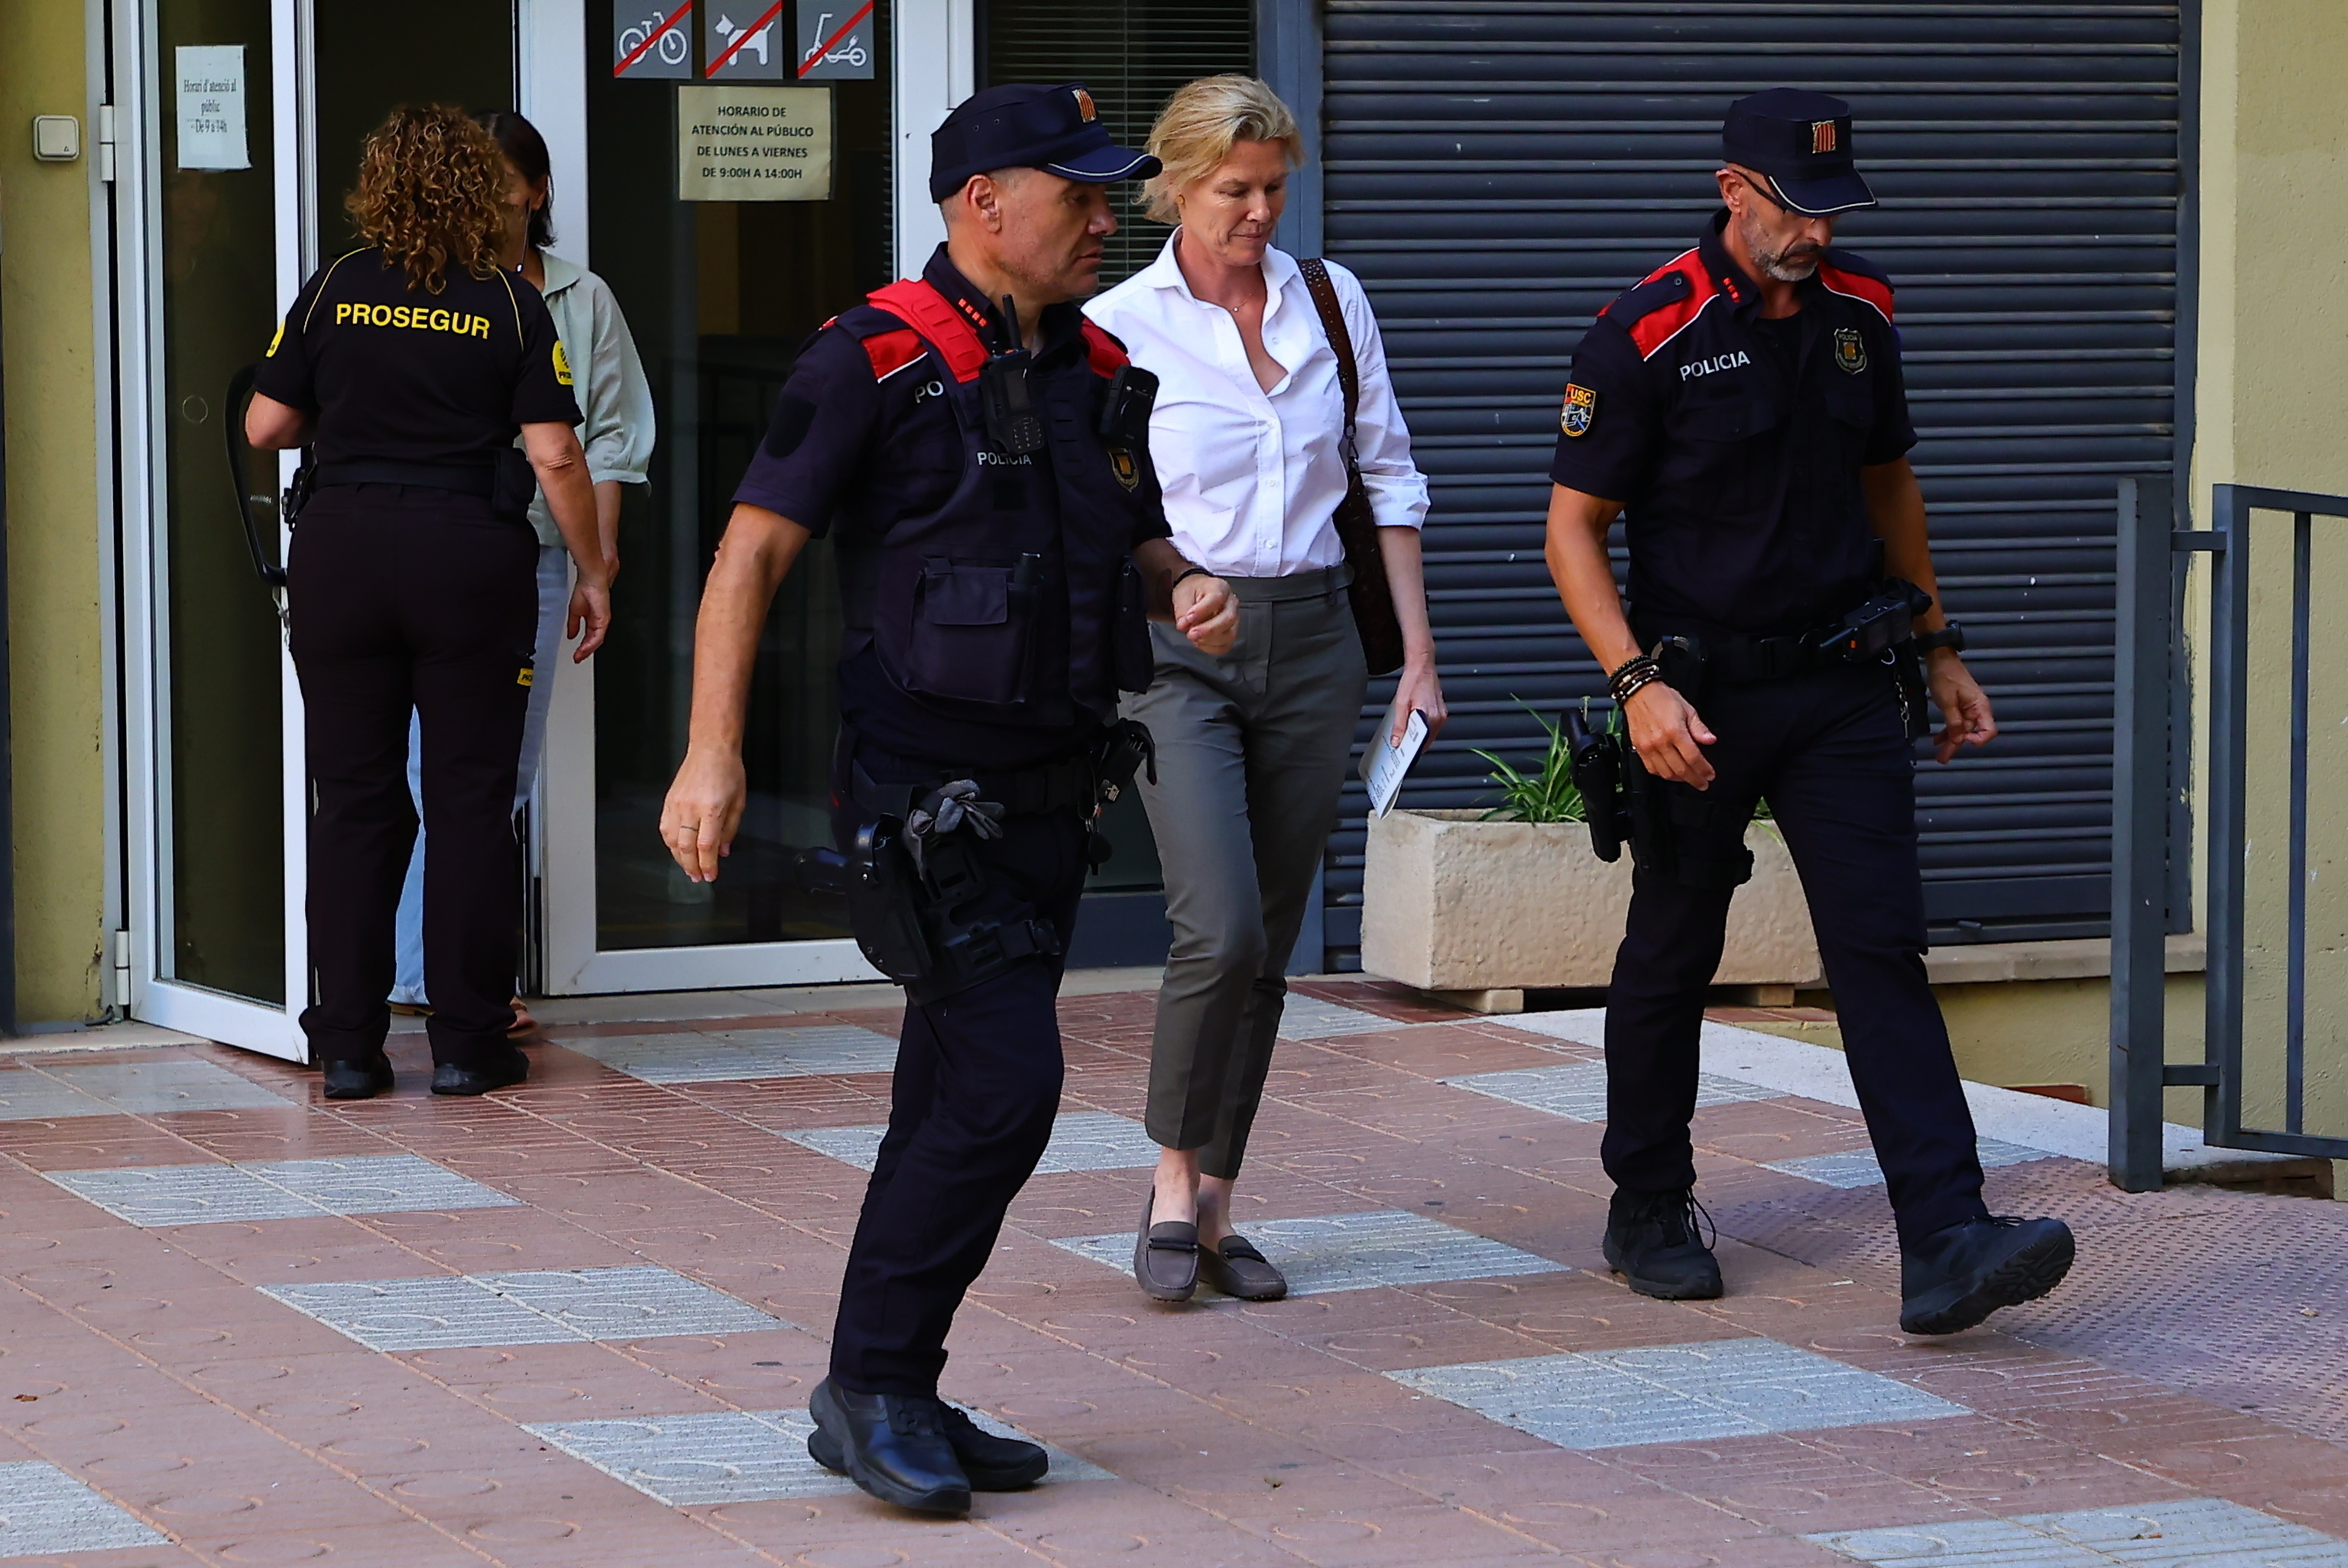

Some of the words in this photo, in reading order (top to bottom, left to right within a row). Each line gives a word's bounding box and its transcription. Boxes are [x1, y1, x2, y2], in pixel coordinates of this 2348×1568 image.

[183, 79, 203, 93] Horari
[203, 78, 230, 92] d'atenció
[231, 78, 236, 92] al
[201, 99, 220, 116] públic
[718, 105, 770, 117] HORARIO
[772, 107, 787, 117] DE
[196, 119, 204, 133] De
[205, 119, 210, 133] 9
[211, 122, 216, 133] a
[691, 123, 748, 136] ATENCIÓN
[750, 126, 764, 136] AL
[767, 124, 814, 137] PÚBLICO
[697, 146, 711, 156] DE
[713, 147, 748, 157] LUNES
[751, 147, 760, 157] A
[762, 147, 808, 158] VIERNES
[702, 167, 716, 177] DE
[719, 167, 751, 178] 9:00H
[754, 169, 761, 178] A
[765, 169, 802, 179] 14:00H
[336, 303, 490, 340] PROSEGUR
[1679, 351, 1751, 381] POLICIA
[915, 381, 944, 403] PO
[1571, 387, 1591, 403] USC
